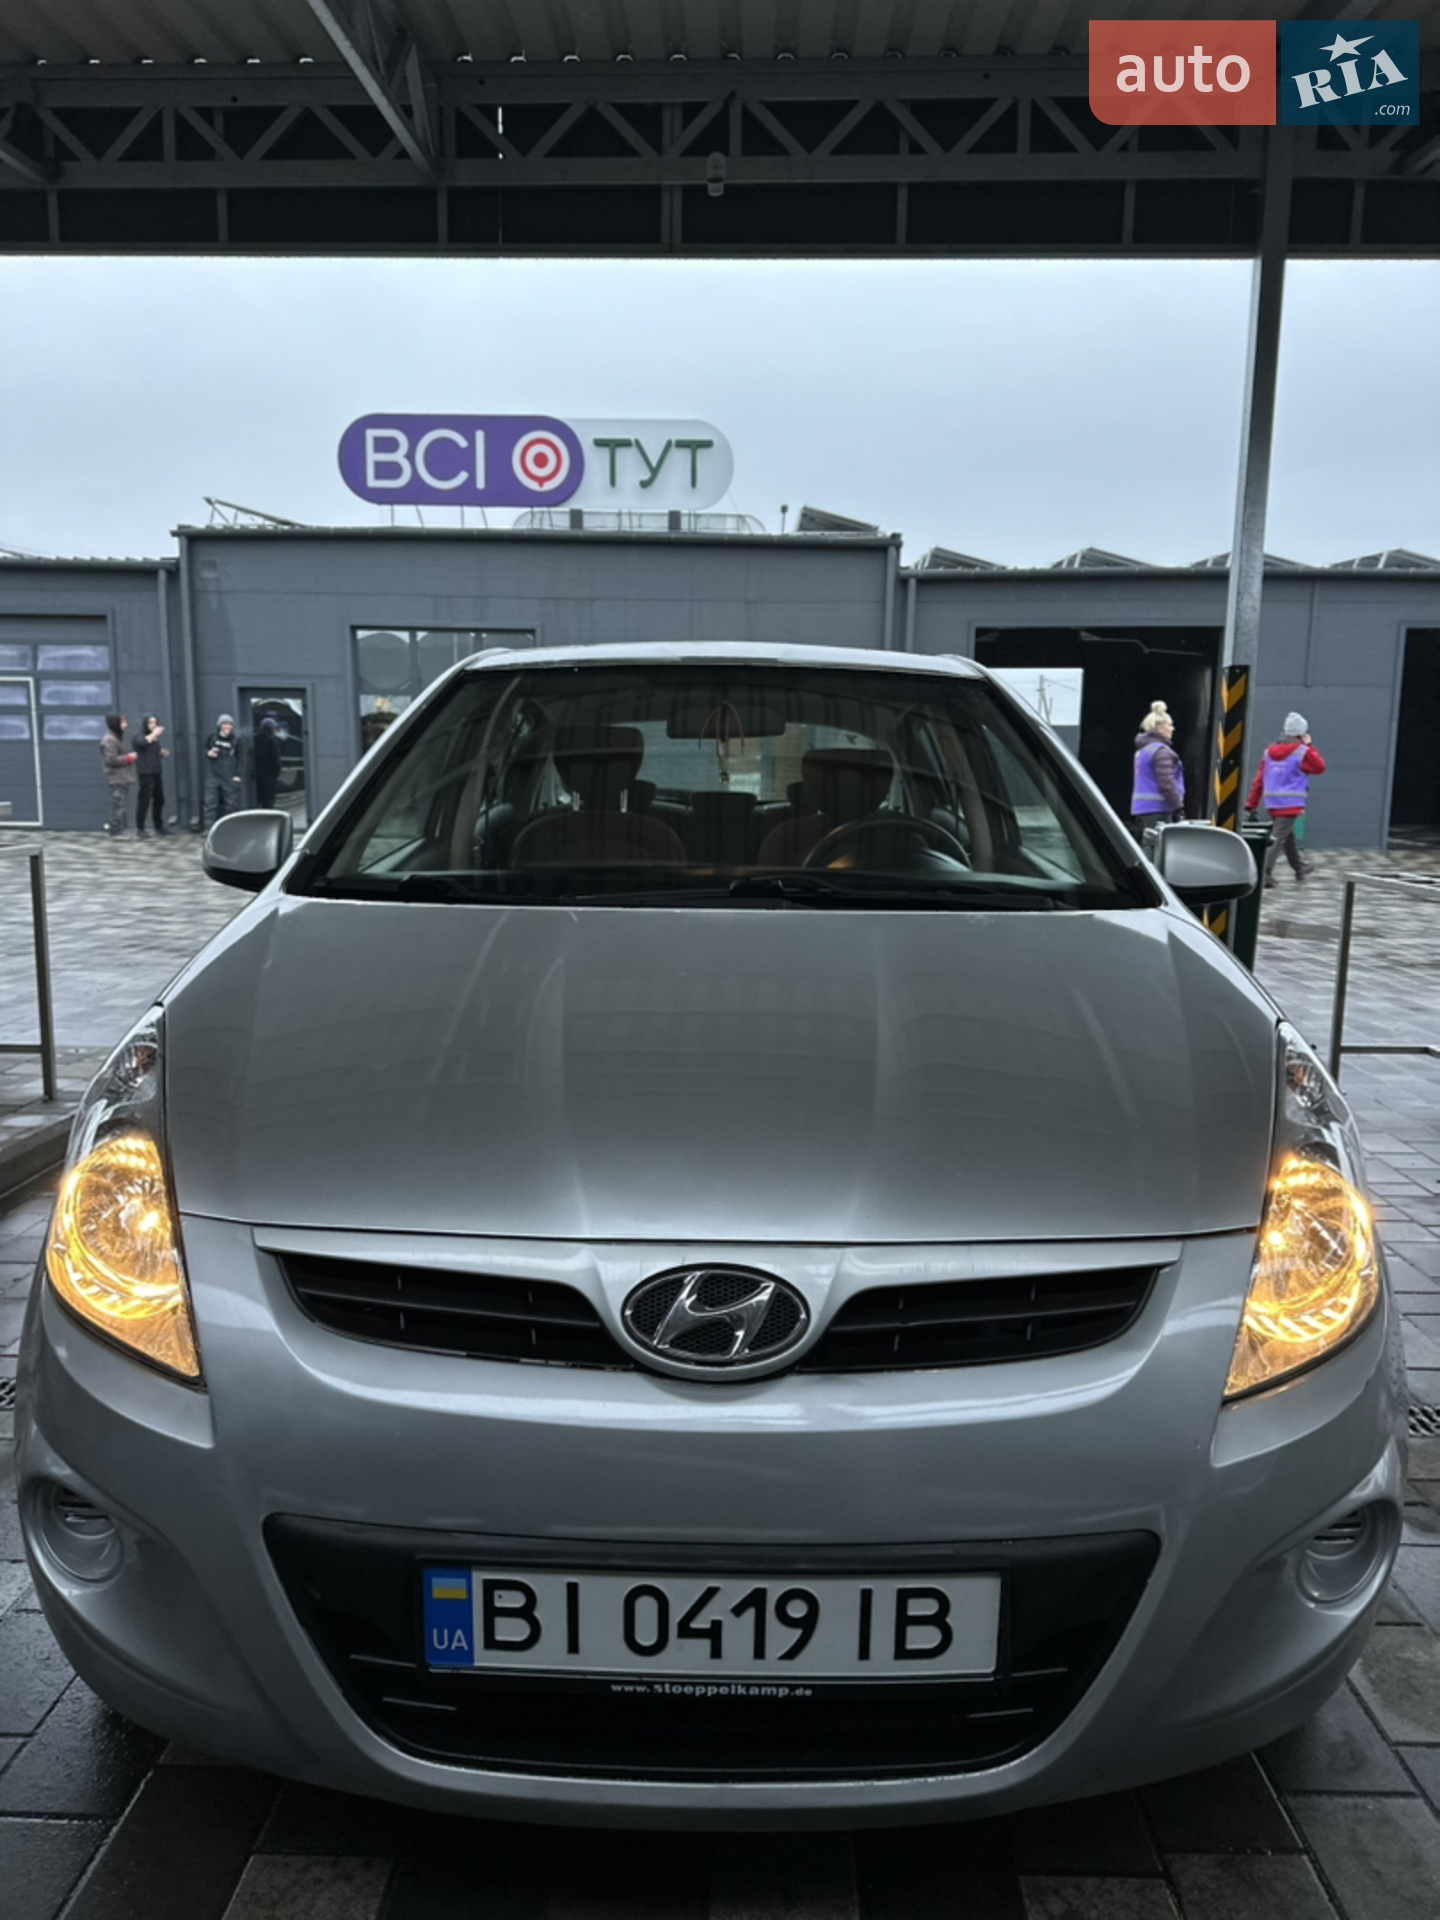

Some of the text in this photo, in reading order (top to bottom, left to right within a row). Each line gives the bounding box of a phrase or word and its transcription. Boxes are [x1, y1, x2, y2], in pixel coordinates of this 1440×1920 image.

[365, 428, 714, 490] ВСІ ТУТ
[433, 1628, 469, 1651] UA
[481, 1578, 954, 1661] BI 0419 IB
